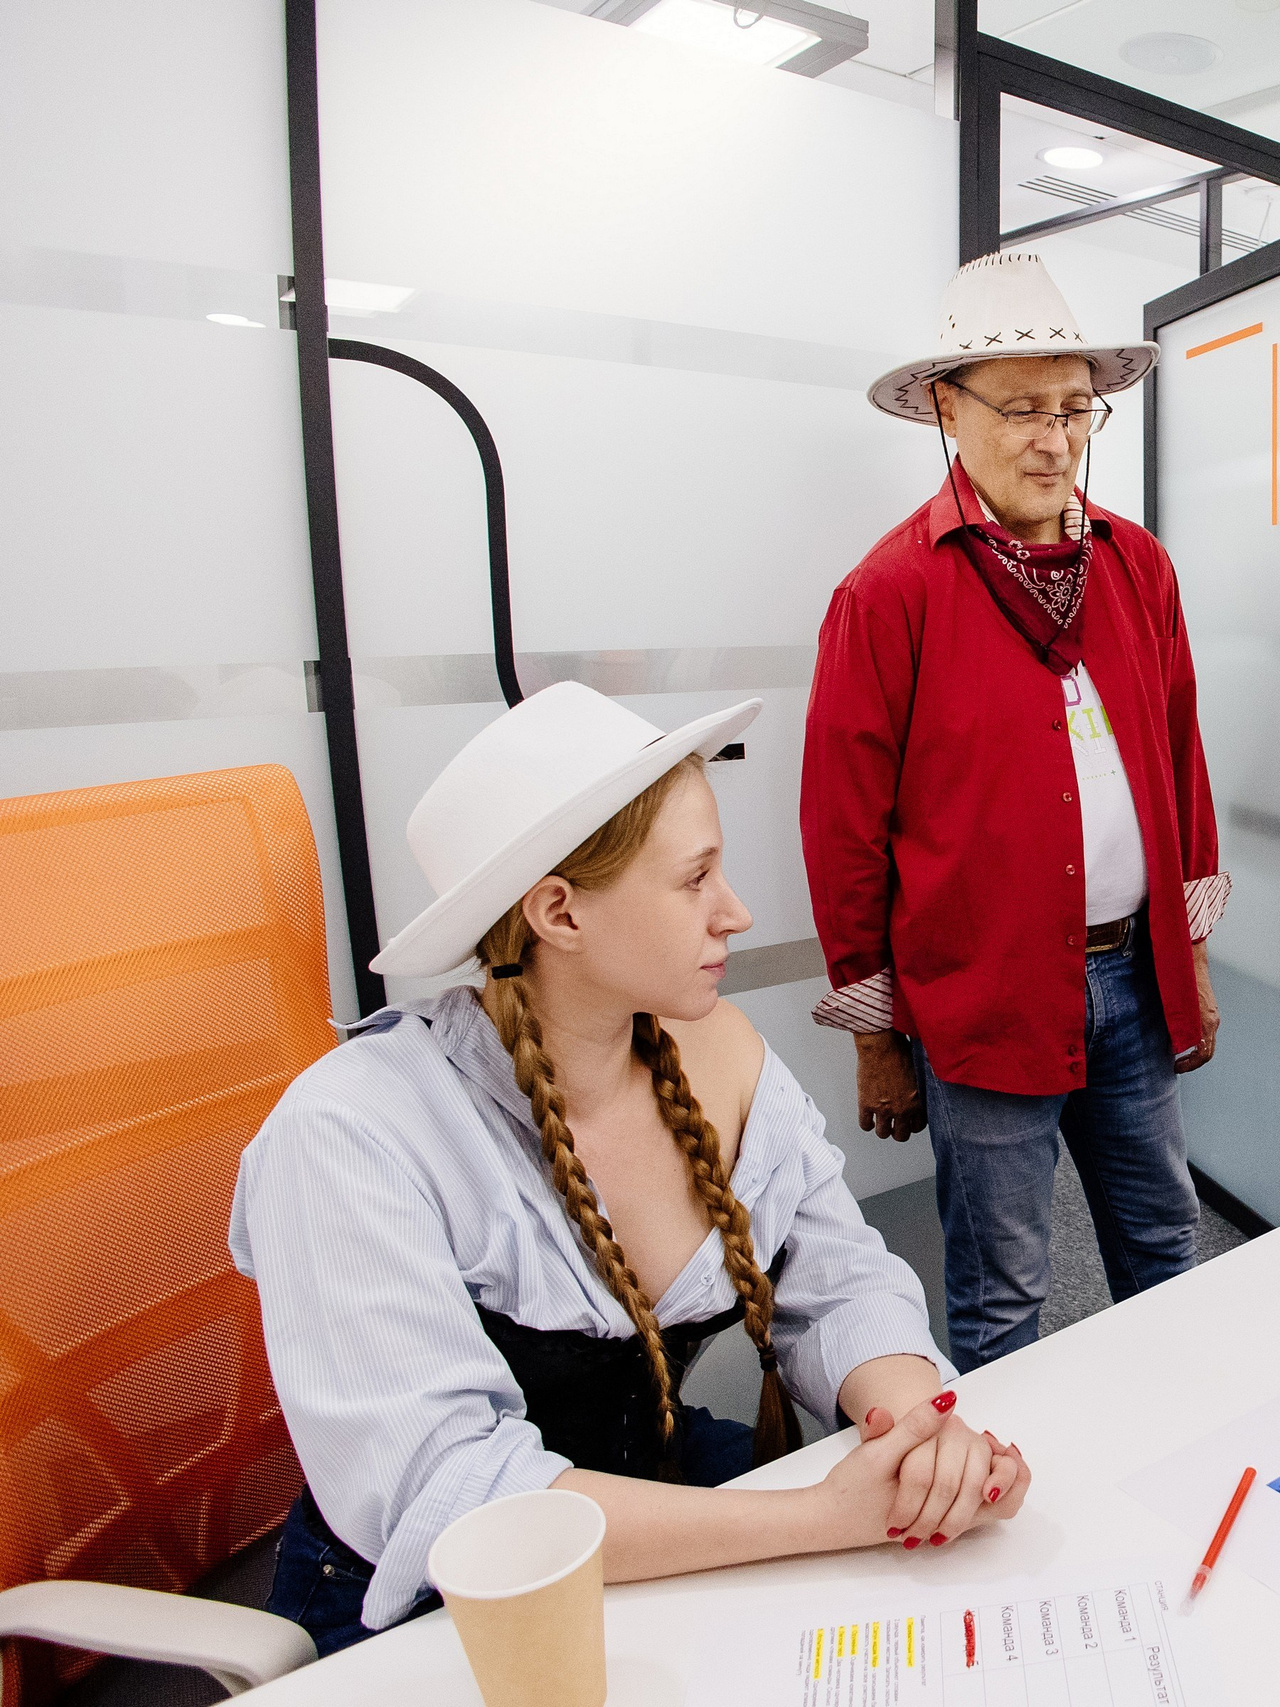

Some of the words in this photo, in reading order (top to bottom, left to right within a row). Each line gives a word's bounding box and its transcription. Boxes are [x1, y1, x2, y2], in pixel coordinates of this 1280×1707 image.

[1114, 1588, 1132, 1634] Команда
[1154, 1580, 1168, 1611] СТАНЦИЯ
[1001, 1605, 1015, 1652] Команда
[1039, 1600, 1054, 1646] Команда
[1077, 1594, 1093, 1640] Команда
[1085, 1642, 1098, 1650] 2
[1045, 1648, 1059, 1656] 3
[1147, 1645, 1169, 1704] Результат
